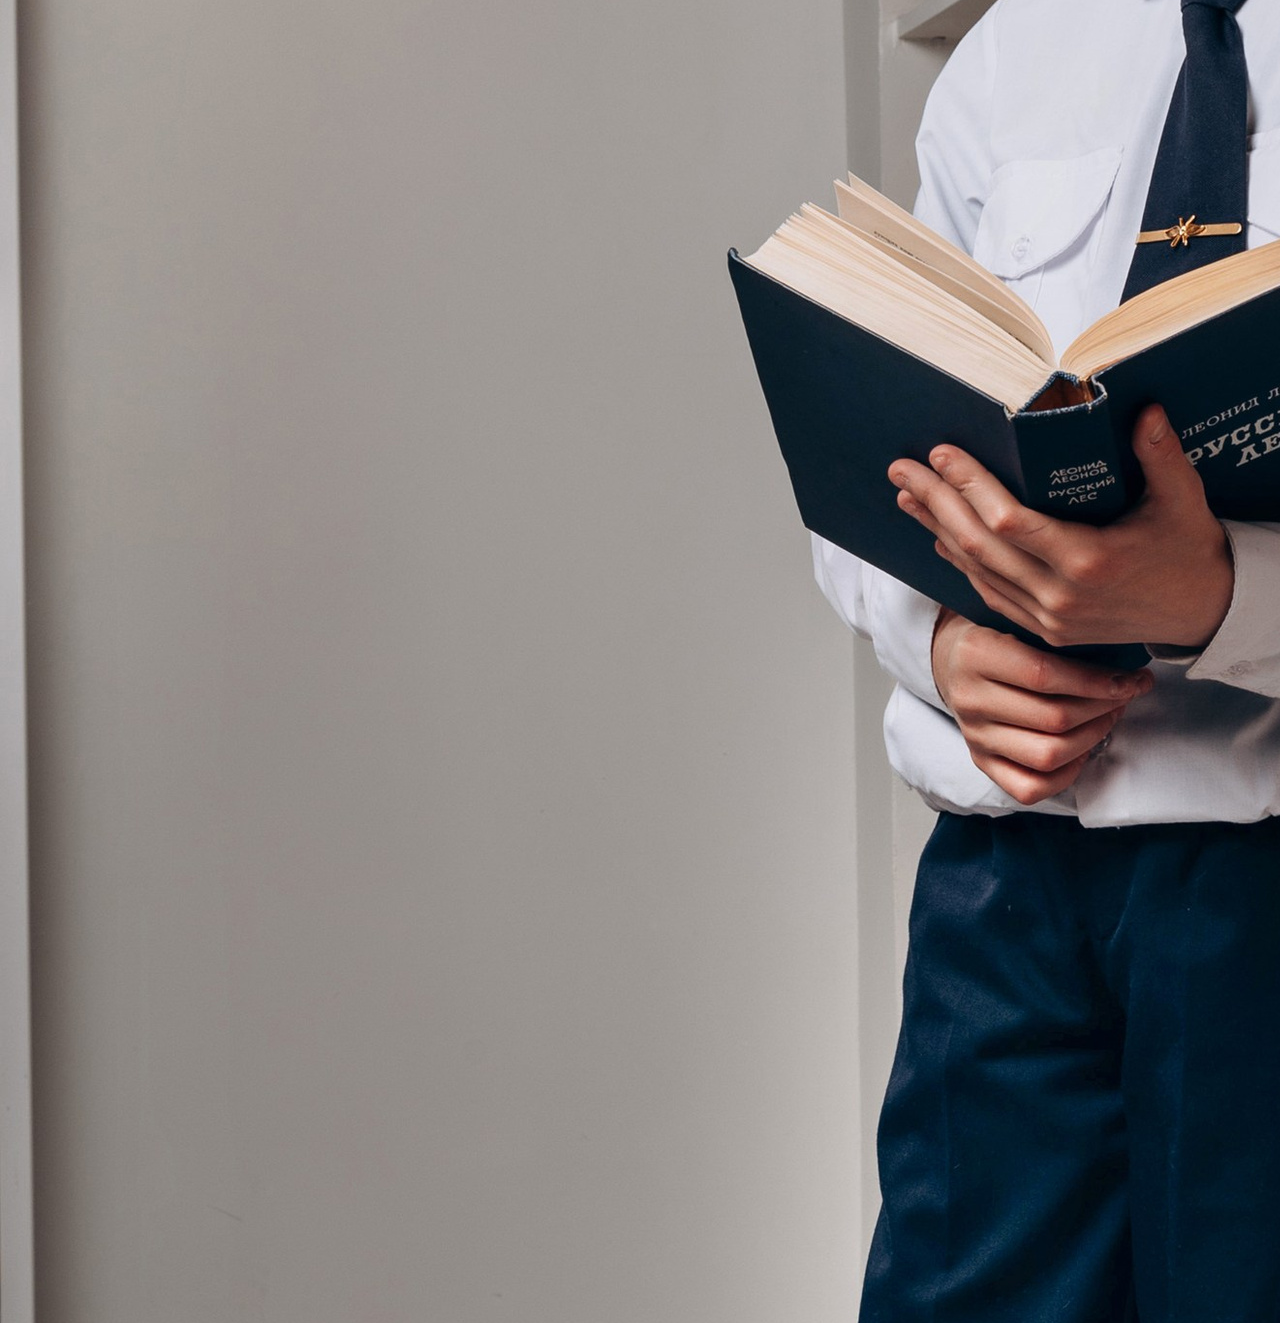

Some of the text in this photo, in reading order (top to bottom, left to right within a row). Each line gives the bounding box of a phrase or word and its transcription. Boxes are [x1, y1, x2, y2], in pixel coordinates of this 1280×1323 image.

[1182, 396, 1260, 440] ЛЕОНИД
[1049, 460, 1107, 478] ЛЕОНИД
[1051, 466, 1108, 485] ЛЕОНОВ
[1048, 475, 1116, 498] РУССКИЙ
[1068, 492, 1098, 505] ЛЕС
